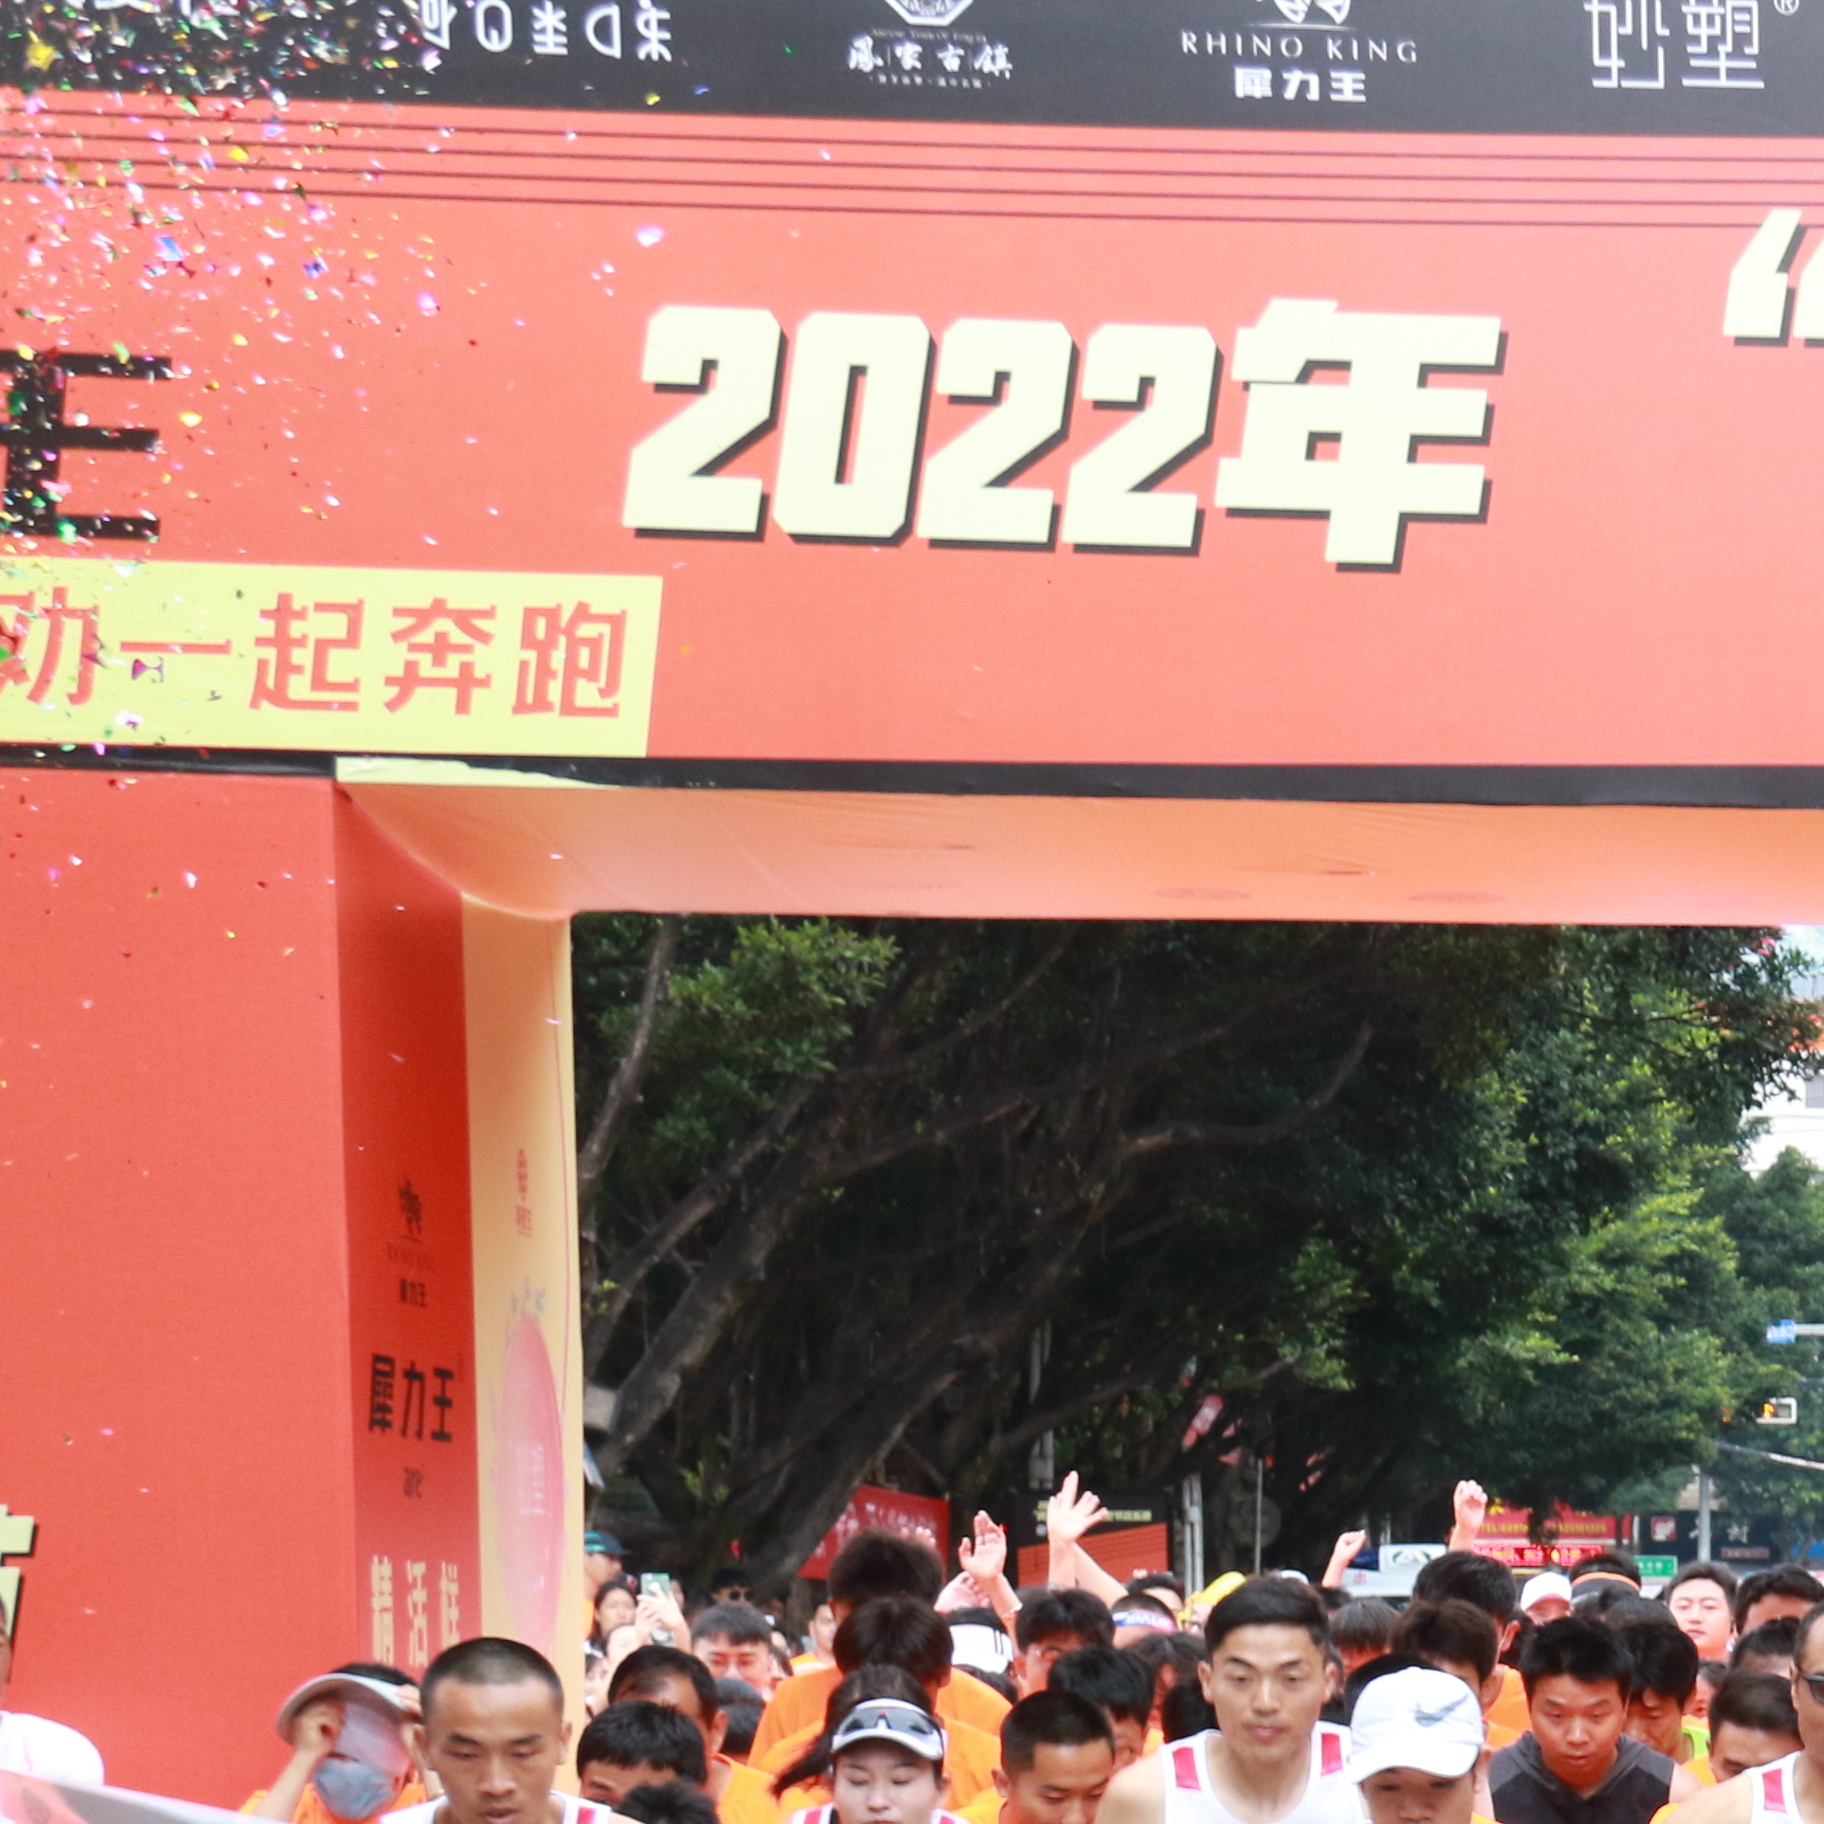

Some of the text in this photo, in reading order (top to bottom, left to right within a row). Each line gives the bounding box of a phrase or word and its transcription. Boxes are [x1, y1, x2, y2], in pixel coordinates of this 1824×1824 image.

[1180, 29, 1418, 63] RHINO KING
[1233, 65, 1367, 103] 犀力王
[620, 297, 1505, 572] 2022年
